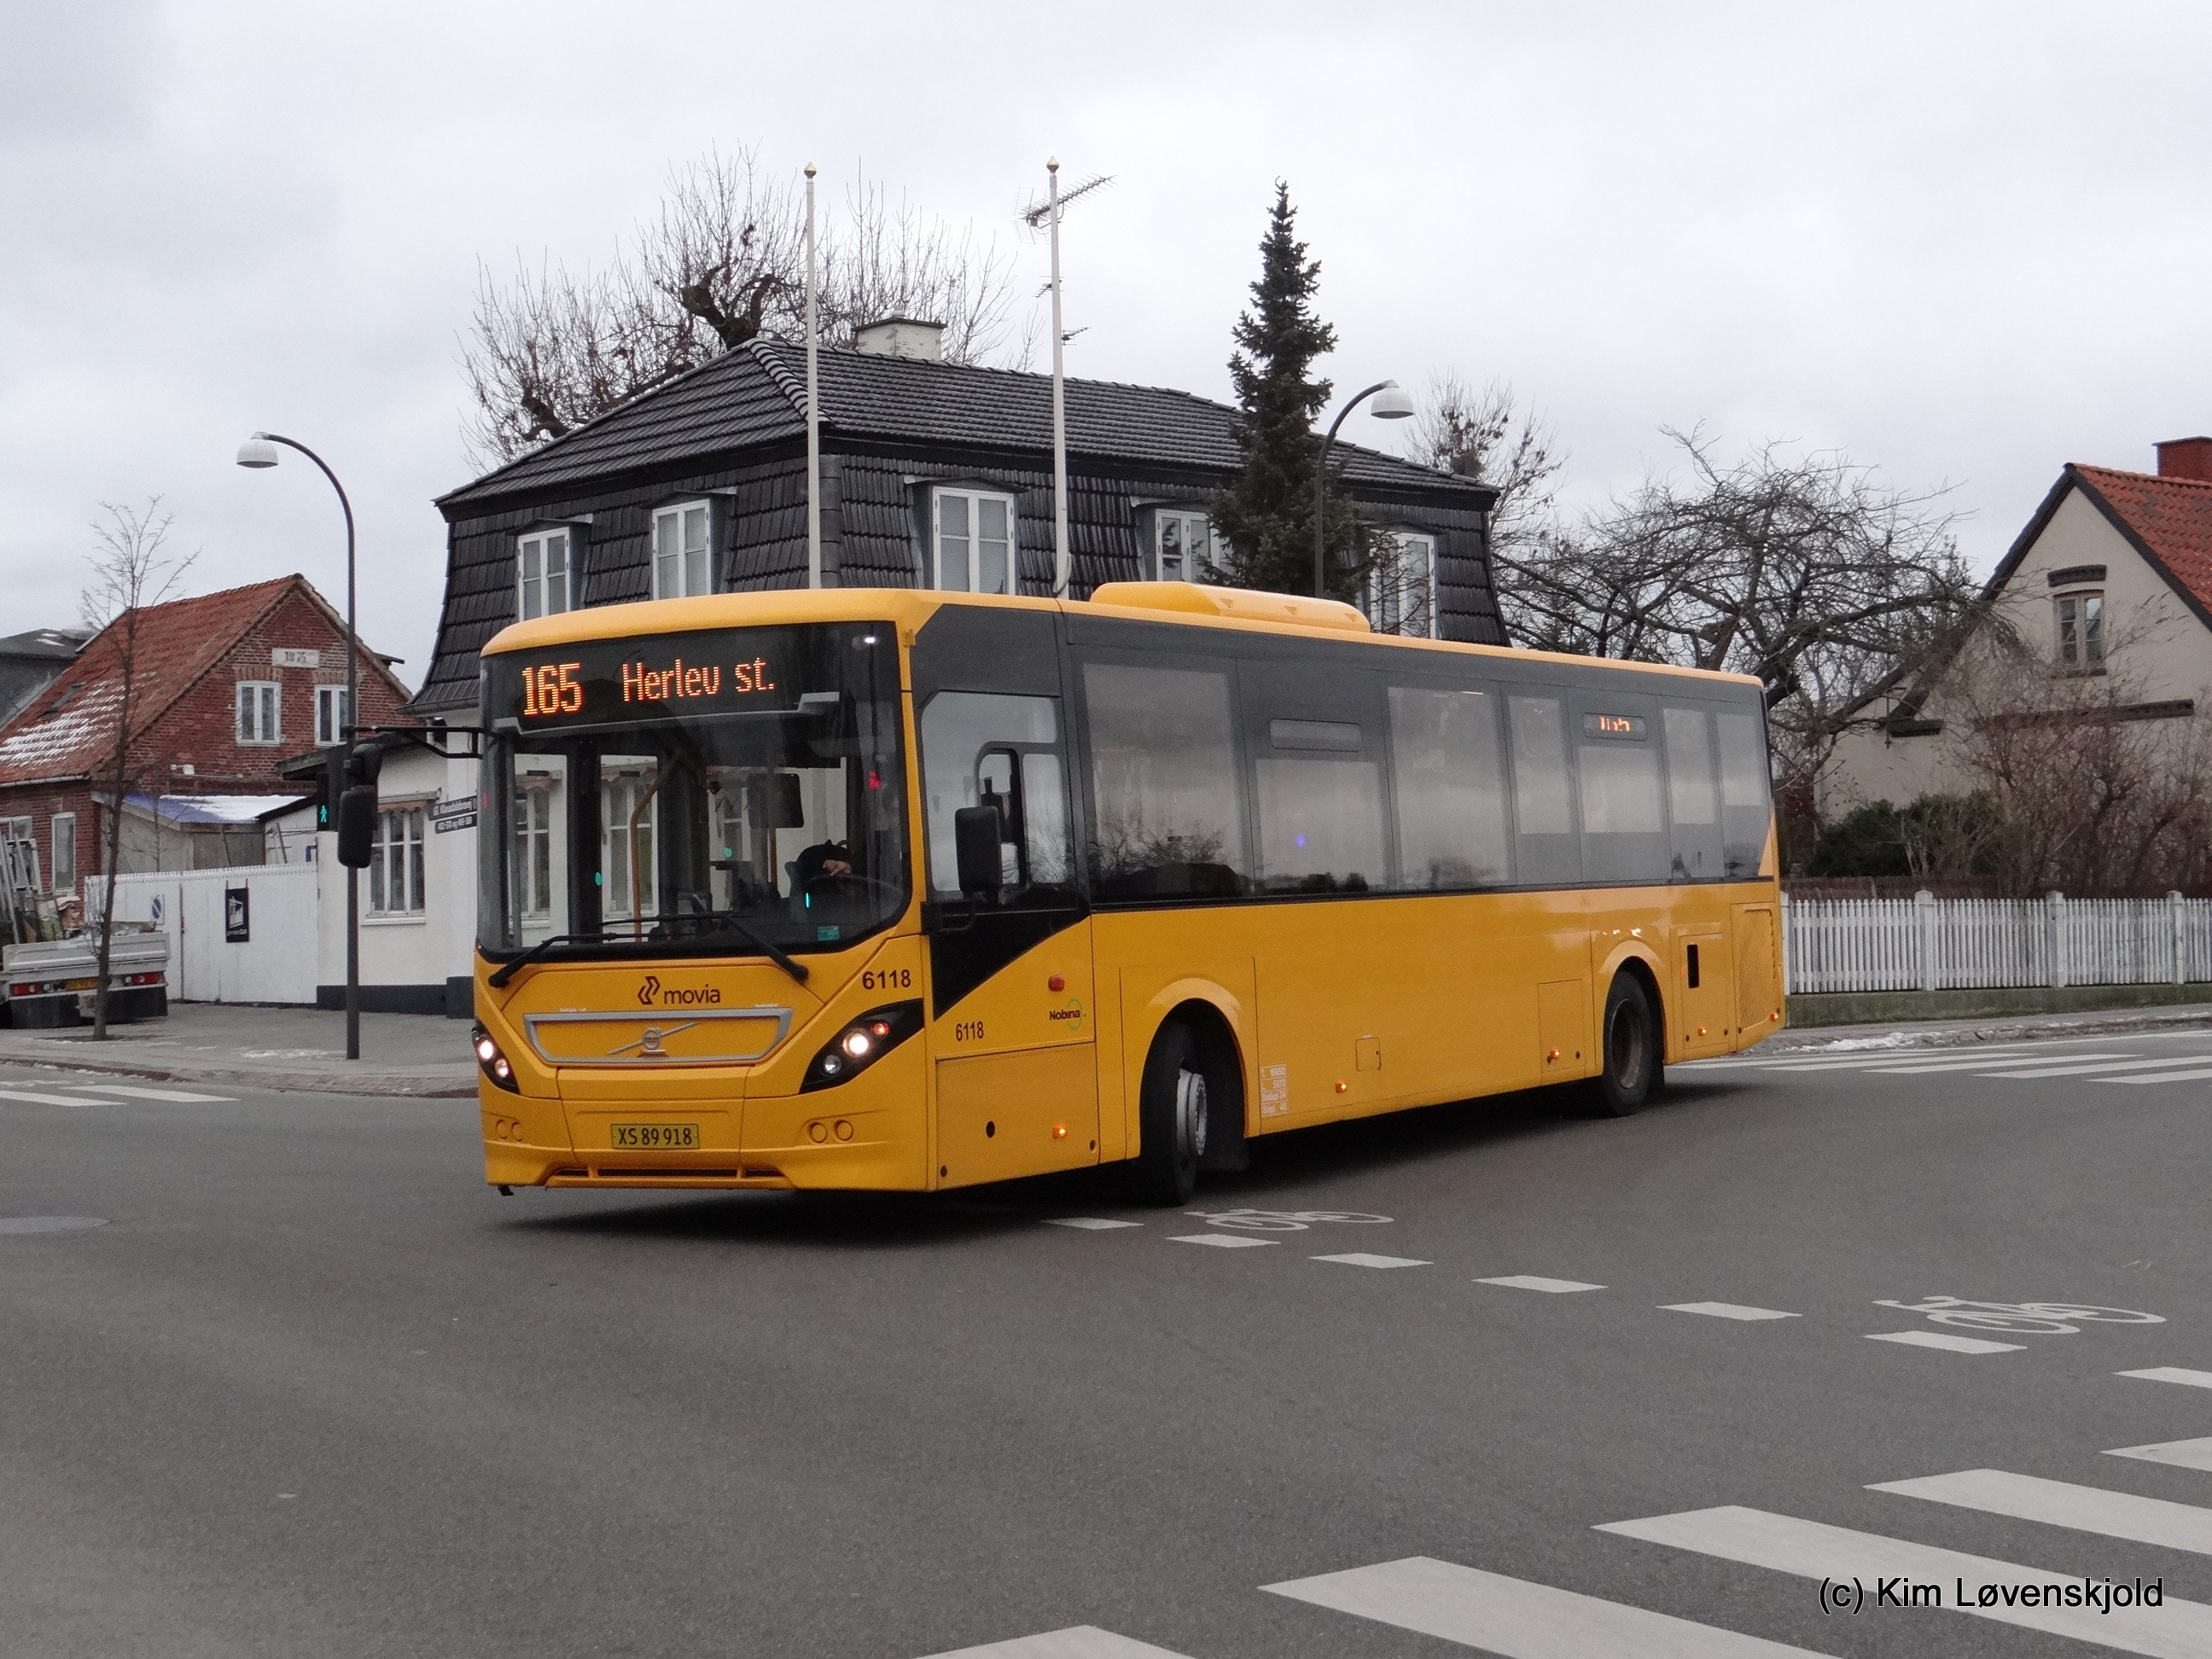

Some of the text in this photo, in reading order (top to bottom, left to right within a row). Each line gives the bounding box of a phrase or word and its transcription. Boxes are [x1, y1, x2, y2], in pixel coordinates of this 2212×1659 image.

[521, 656, 776, 716] 165 Herlev st.
[862, 969, 911, 990] 6118
[663, 984, 721, 1005] movia
[1049, 1008, 1080, 1021] Nobina
[955, 1021, 984, 1041] 6118
[618, 1127, 692, 1145] XS 89 918
